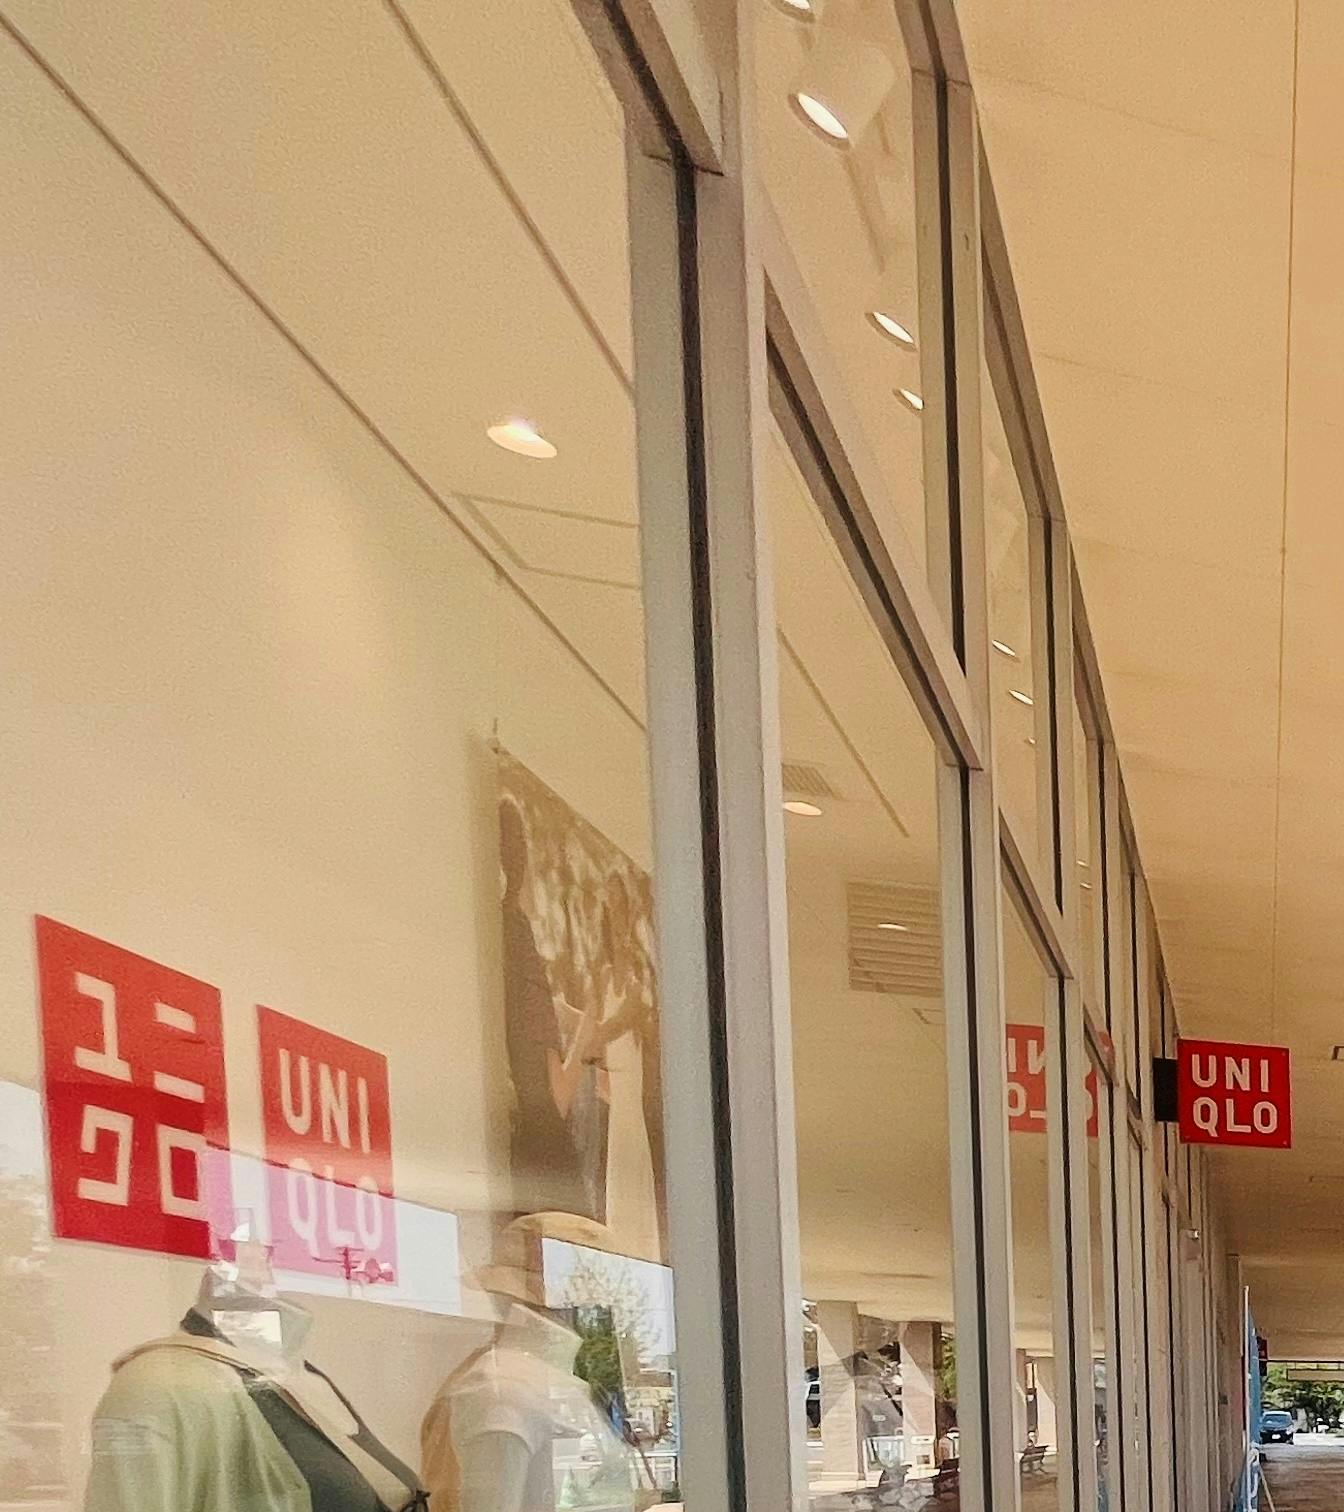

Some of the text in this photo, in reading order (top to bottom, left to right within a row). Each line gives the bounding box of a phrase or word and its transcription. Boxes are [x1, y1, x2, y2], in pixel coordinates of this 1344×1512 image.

[74, 971, 205, 1104] ユニ
[1191, 1053, 1270, 1093] UNI
[279, 1048, 371, 1155] UNI
[1192, 1096, 1278, 1138] QLO
[78, 1104, 209, 1223] クロ
[287, 1158, 383, 1259] QLO
